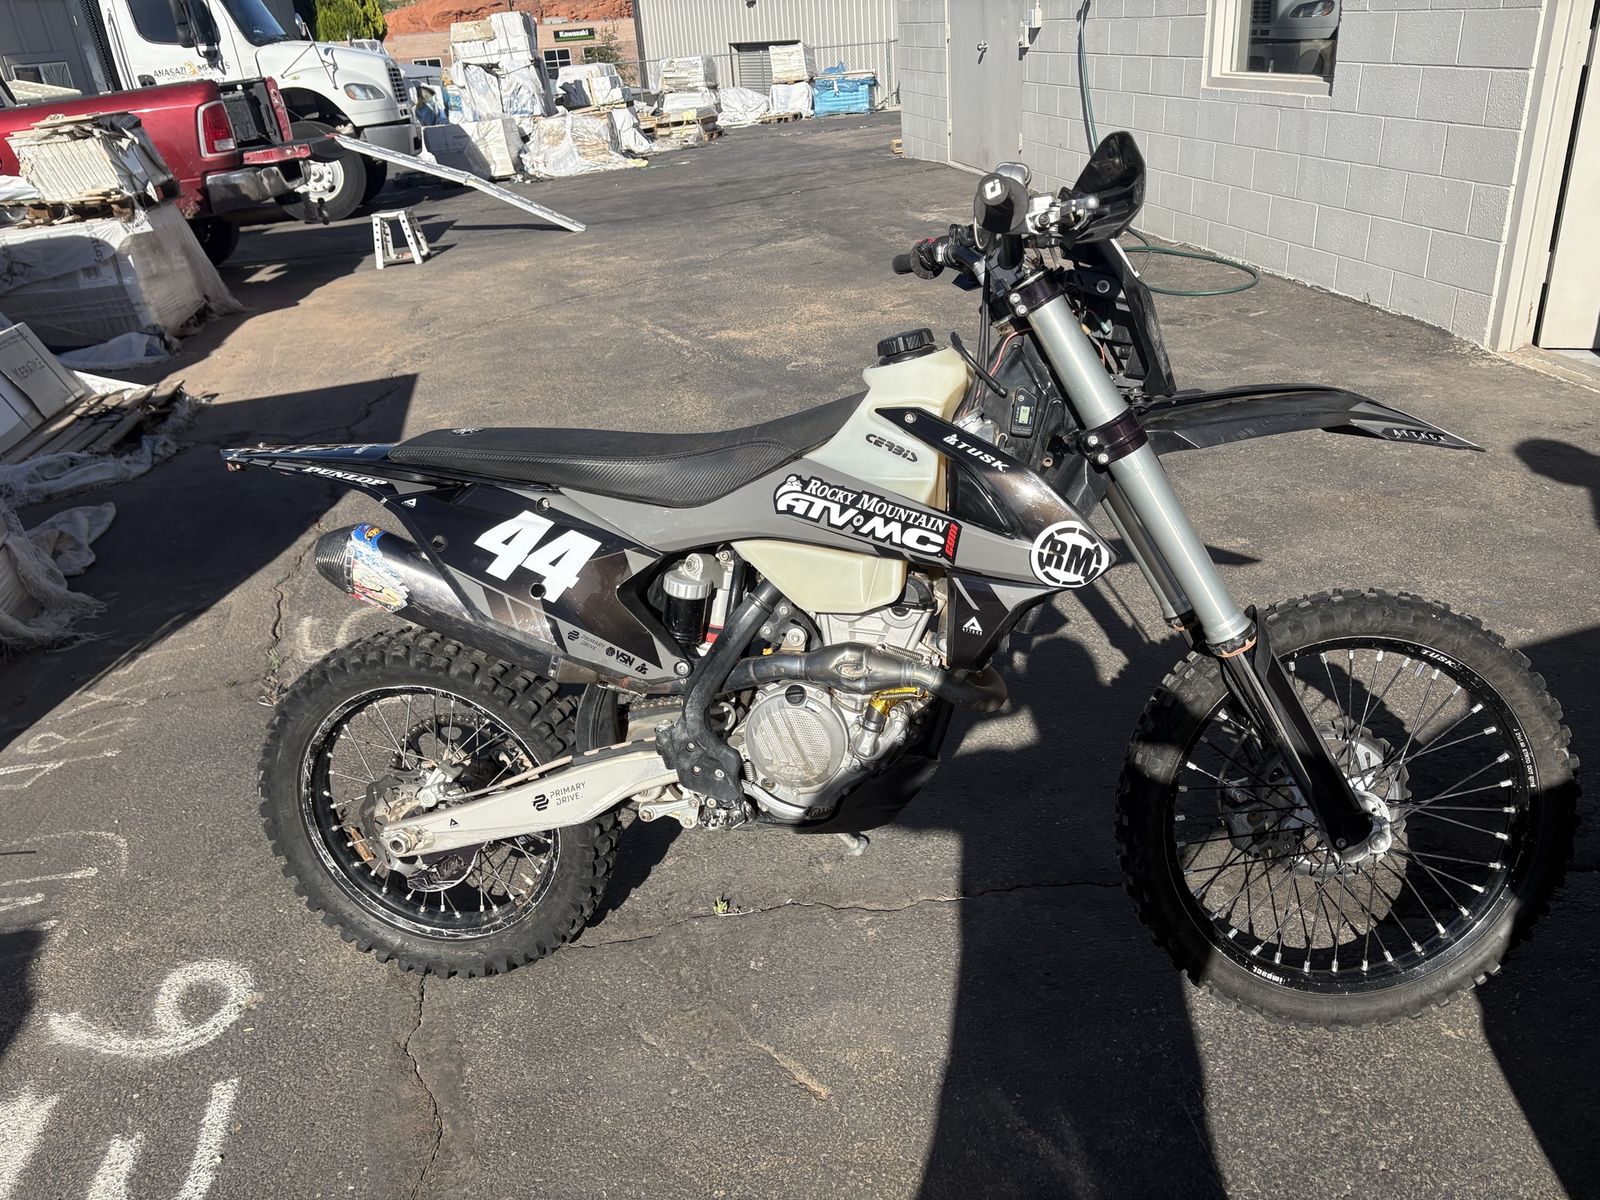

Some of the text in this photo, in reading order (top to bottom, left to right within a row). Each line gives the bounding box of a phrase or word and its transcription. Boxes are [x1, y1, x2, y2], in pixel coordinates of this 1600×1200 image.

[558, 29, 589, 37] Kawasaki
[196, 61, 231, 72] IMPS
[958, 441, 1011, 473] TUSK
[302, 466, 388, 486] DUNLOP
[806, 479, 950, 533] ROCKY MOUNTAIN
[473, 509, 602, 604] 44
[1044, 538, 1095, 578] RM
[580, 634, 606, 649] PRIMARY
[616, 650, 635, 667] VSN
[1421, 649, 1457, 669] TUSK
[550, 781, 586, 798] PRIMARY
[1252, 965, 1284, 984] impact
